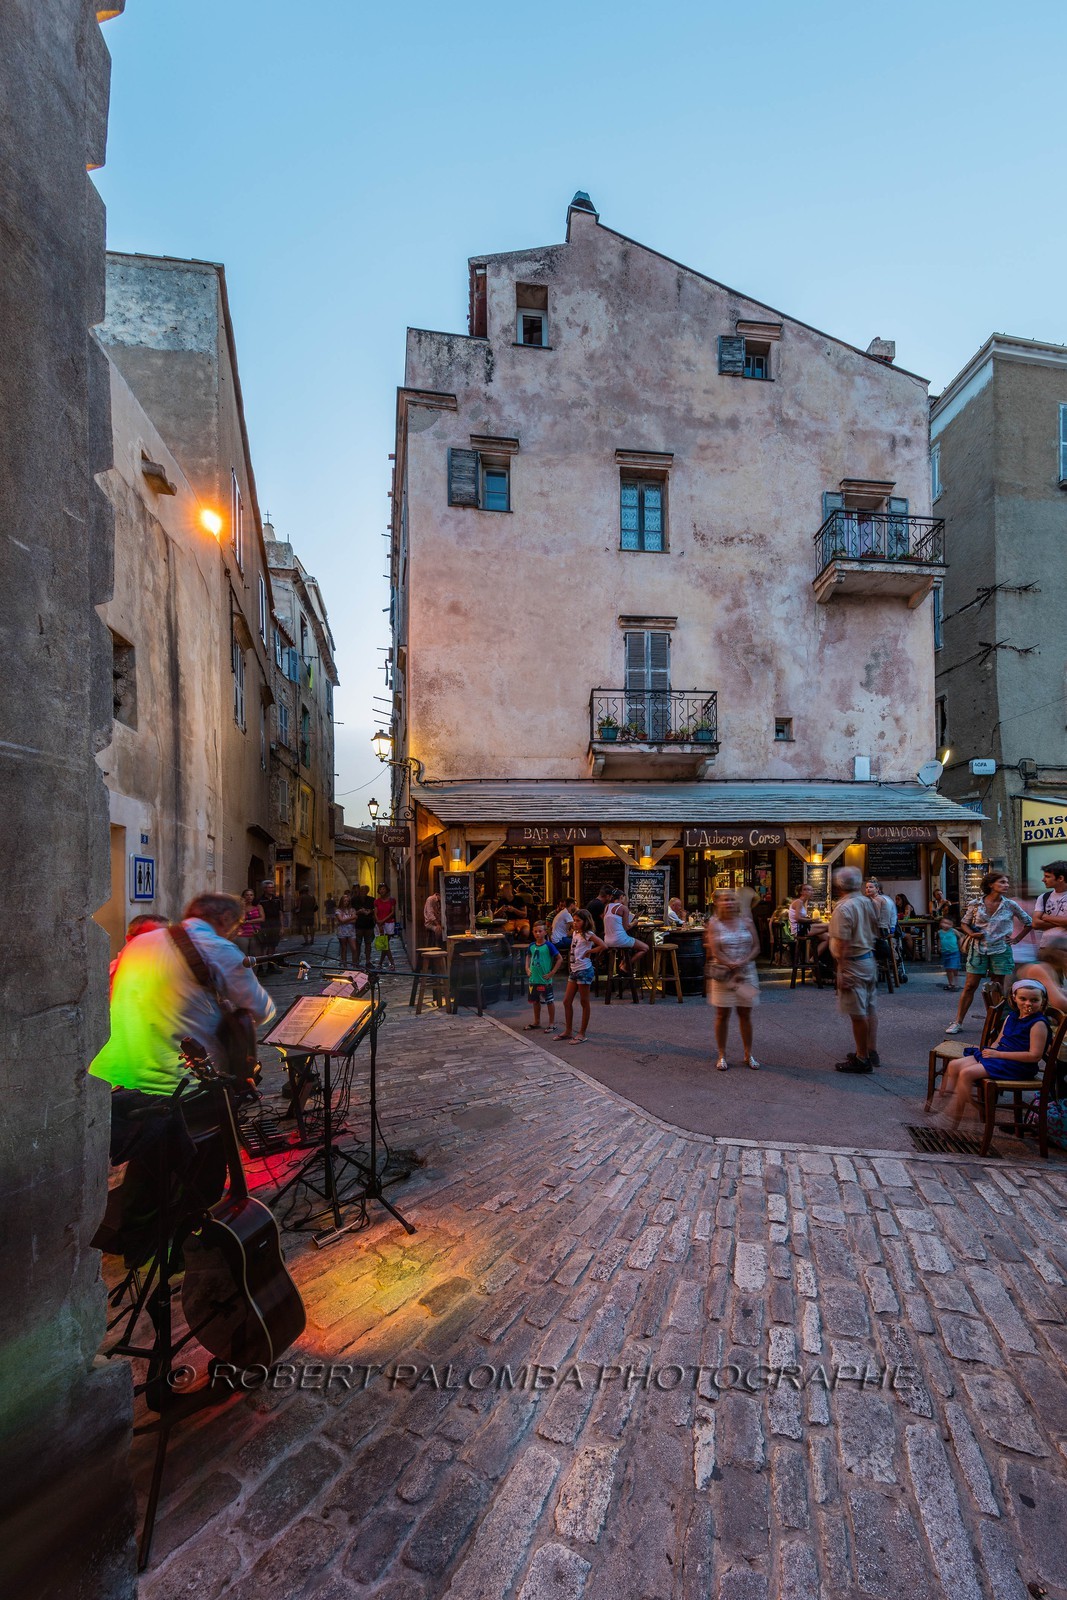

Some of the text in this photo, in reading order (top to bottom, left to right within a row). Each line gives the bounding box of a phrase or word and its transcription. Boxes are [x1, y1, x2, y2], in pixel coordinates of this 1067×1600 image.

[382, 834, 405, 844] Corse
[523, 827, 549, 840] BAR
[562, 827, 587, 840] VIN
[685, 828, 780, 847] L'Auberge Corse
[867, 826, 931, 839] CUCINA CORSA
[1023, 827, 1066, 841] BONA
